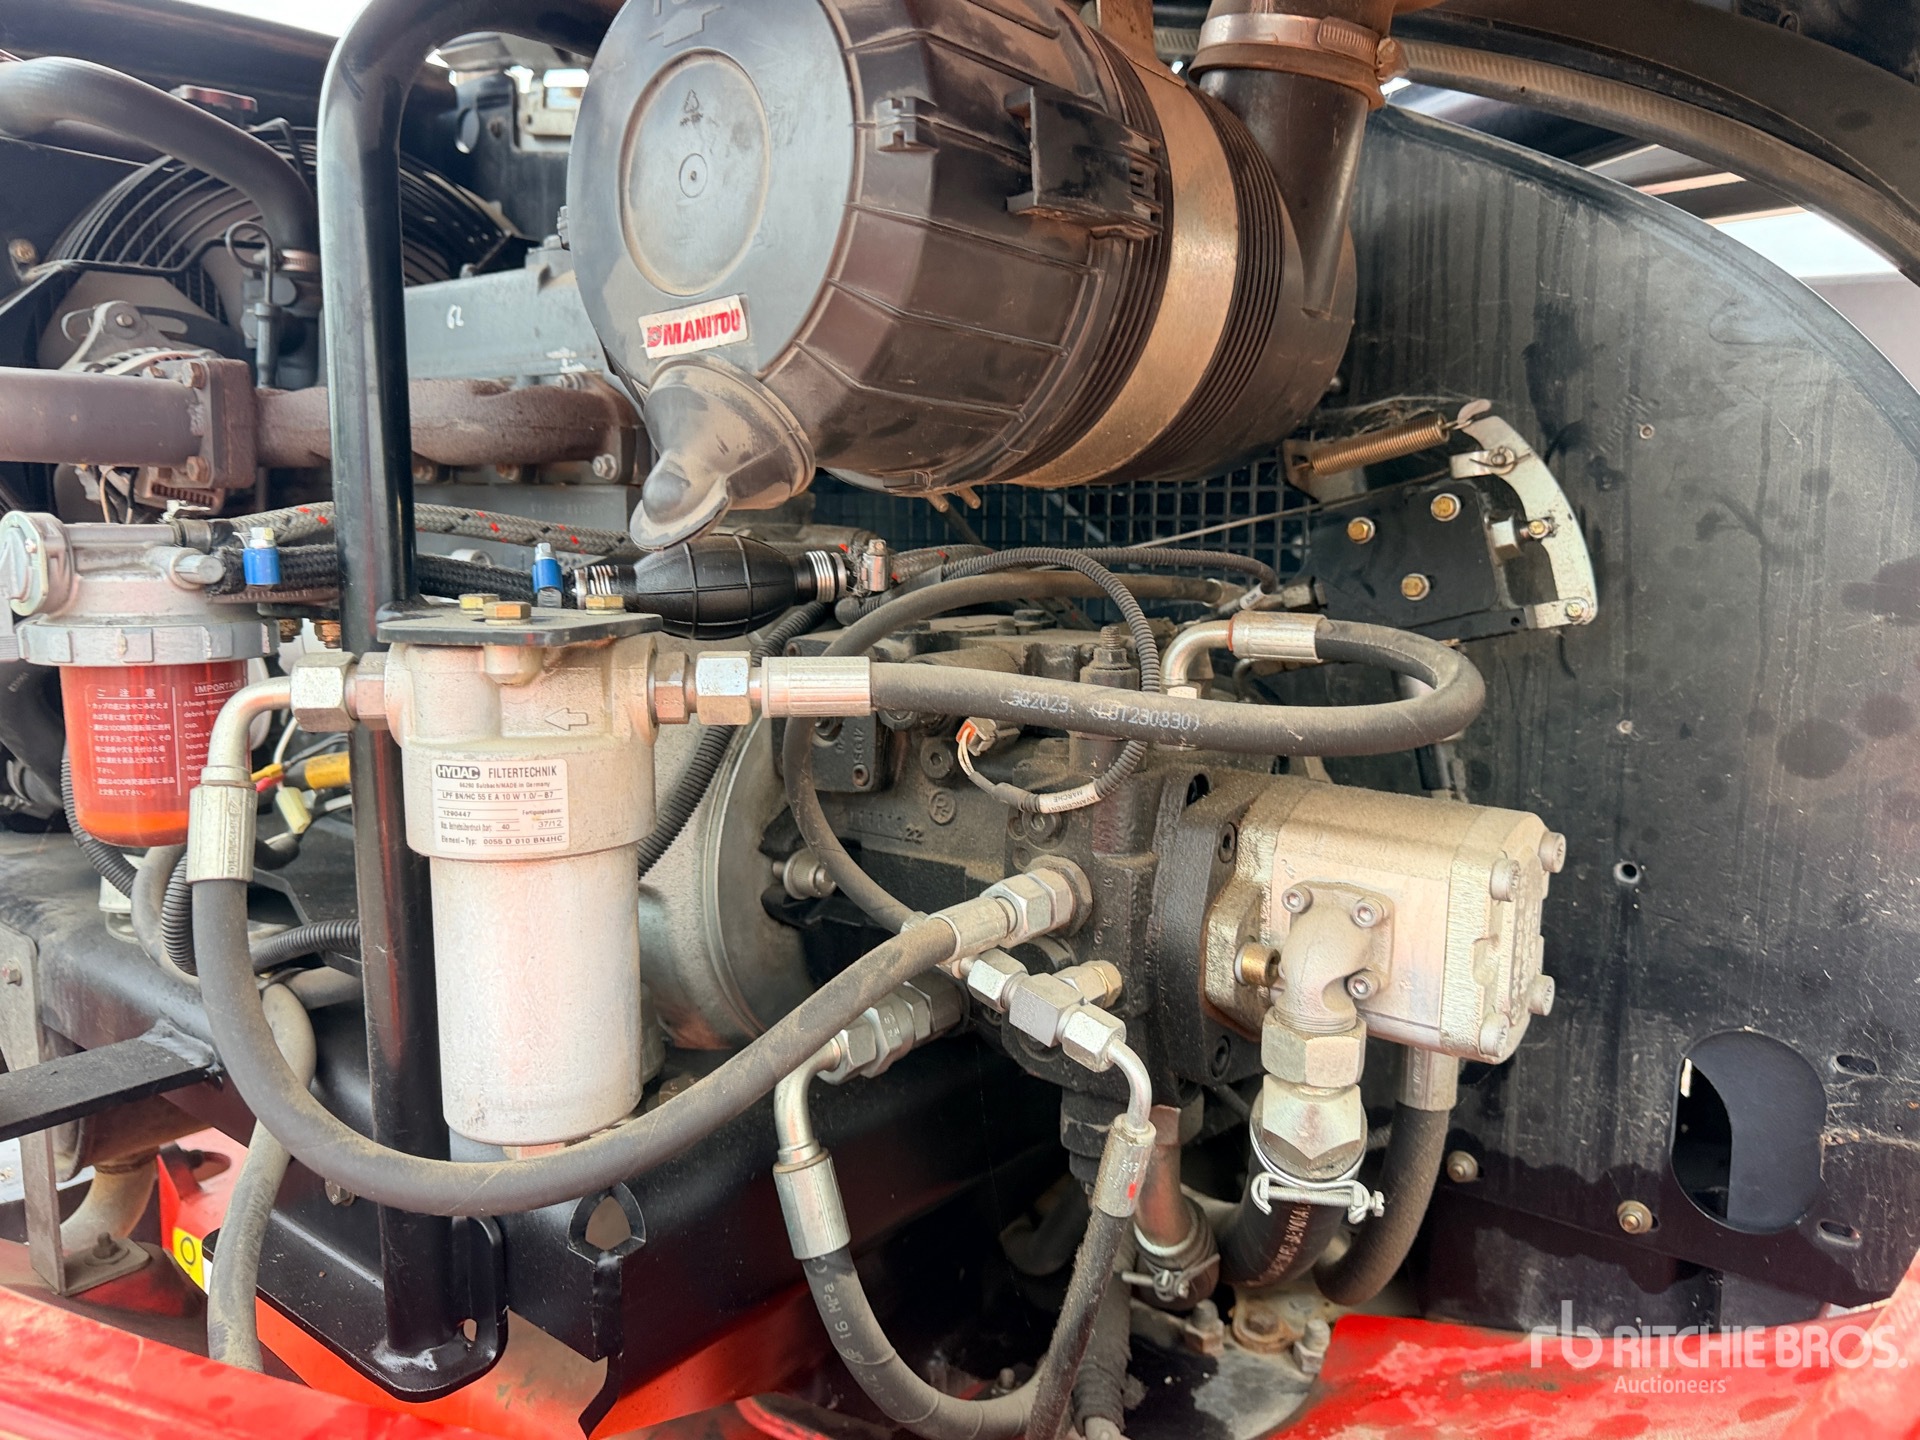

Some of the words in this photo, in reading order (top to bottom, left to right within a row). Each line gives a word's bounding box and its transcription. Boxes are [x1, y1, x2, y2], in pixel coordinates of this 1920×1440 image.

[663, 308, 741, 346] MANITOU
[437, 765, 480, 780] HYDAC
[488, 765, 557, 779] FILTERTECHNIK
[442, 791, 453, 799] LPF
[455, 792, 476, 800] BN/HC
[478, 792, 486, 800] 55
[502, 792, 511, 800] 10
[513, 792, 520, 800] W
[1053, 790, 1083, 802] MARCHE
[538, 819, 562, 828] 37/12
[483, 837, 503, 845] 0055
[533, 834, 563, 844] BN4HC
[824, 1282, 841, 1313] MPa
[835, 1321, 852, 1339] 16
